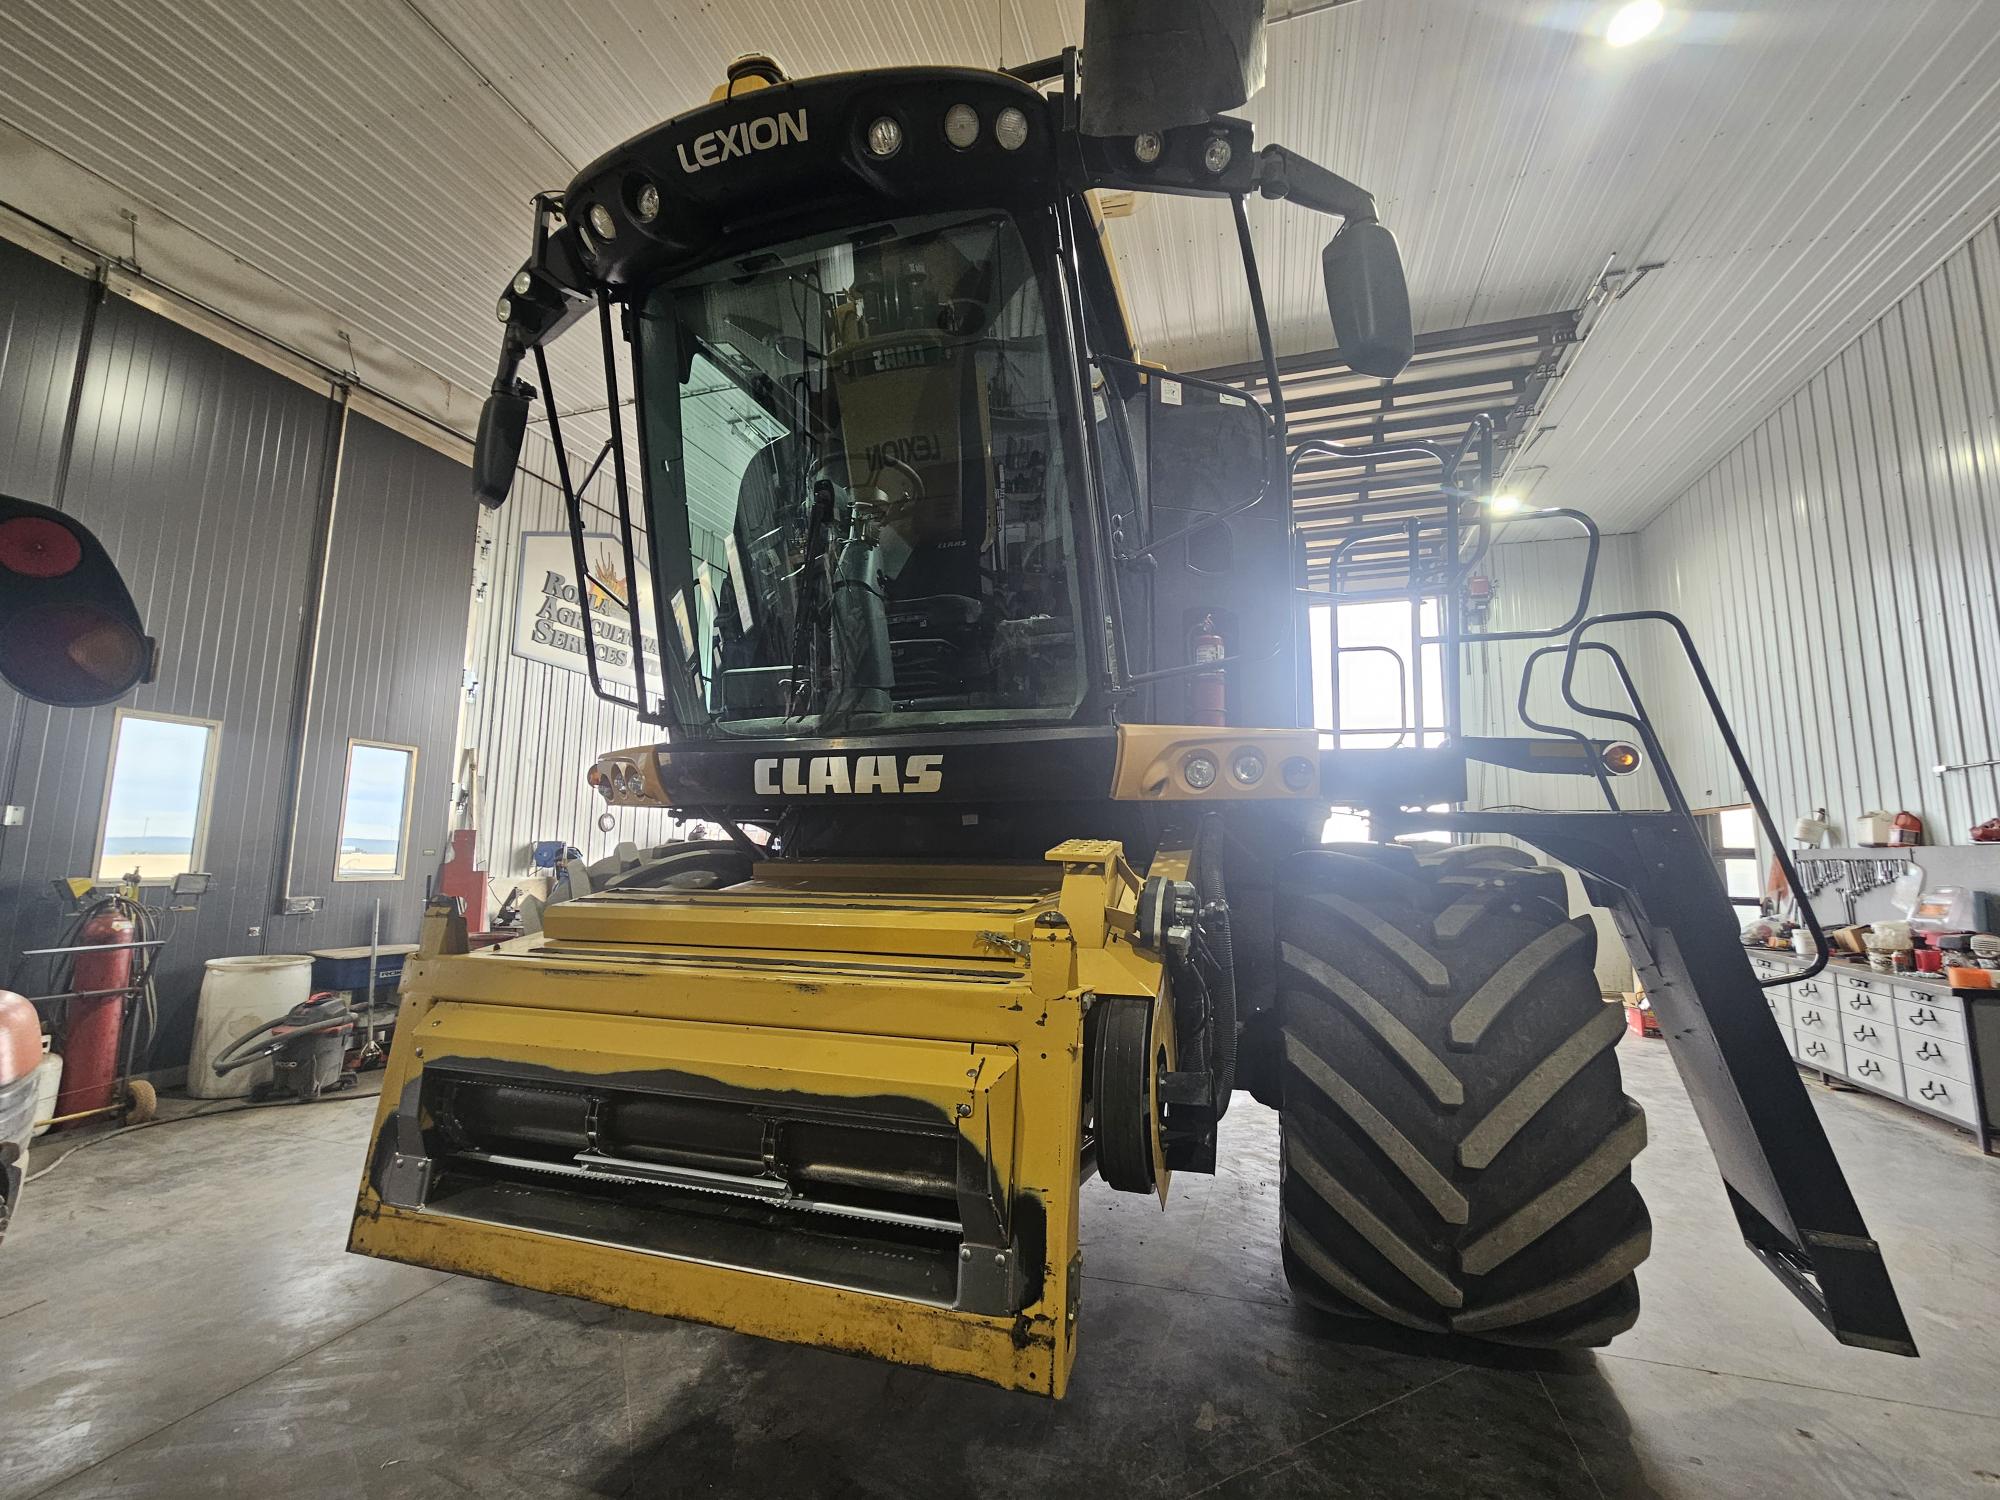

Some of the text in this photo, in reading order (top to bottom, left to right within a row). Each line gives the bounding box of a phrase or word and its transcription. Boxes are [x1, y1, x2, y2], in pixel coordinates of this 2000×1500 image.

[676, 108, 809, 174] LEXION
[541, 570, 611, 617] ROLA
[753, 754, 944, 795] CLAAS
